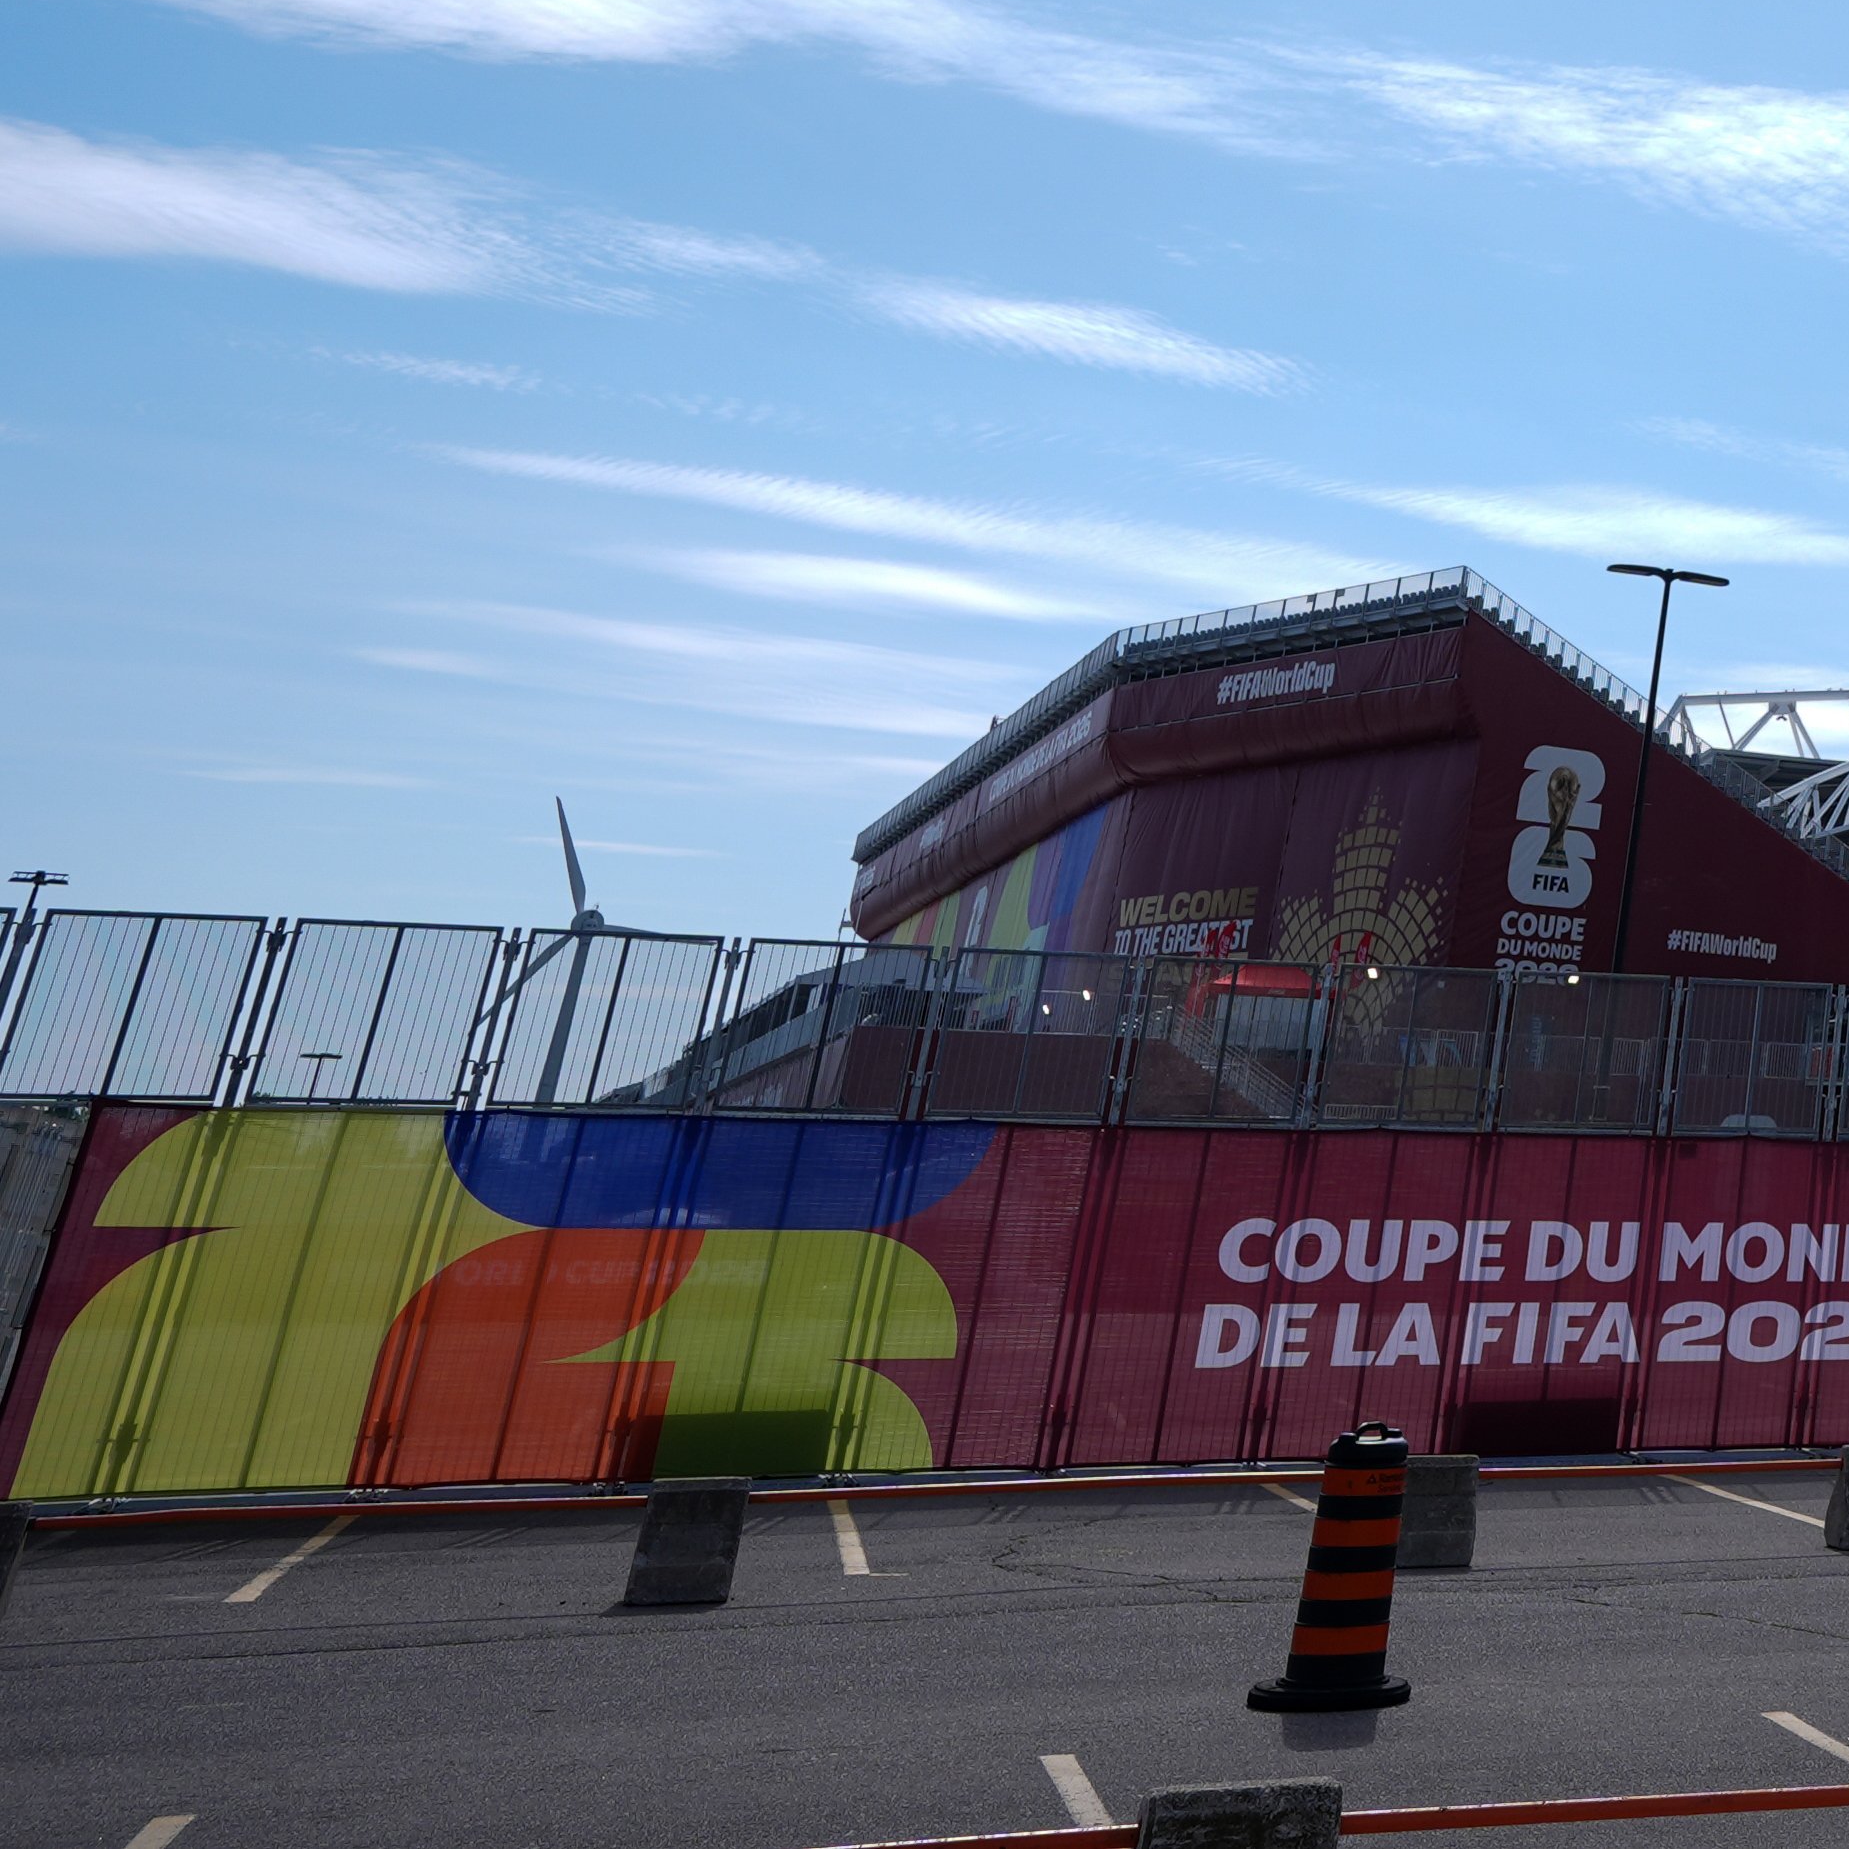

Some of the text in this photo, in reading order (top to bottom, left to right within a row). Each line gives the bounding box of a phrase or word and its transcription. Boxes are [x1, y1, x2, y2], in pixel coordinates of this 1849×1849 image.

[1217, 661, 1336, 705] #FIFAWorldCup
[1532, 873, 1569, 893] FIFA
[1119, 886, 1260, 928] WELCOME
[1115, 928, 1131, 956] TO
[1132, 925, 1161, 955] THE
[1500, 910, 1588, 942] COUPE
[1496, 937, 1583, 961] DU MONDE
[1666, 928, 1778, 965] #FIFAWorldCup
[1218, 1217, 1512, 1284] COUPE
[1525, 1220, 1641, 1283] DU
[1195, 1303, 1318, 1369] DE
[1330, 1302, 1441, 1367] LA
[1461, 1301, 1640, 1366] FIFA
